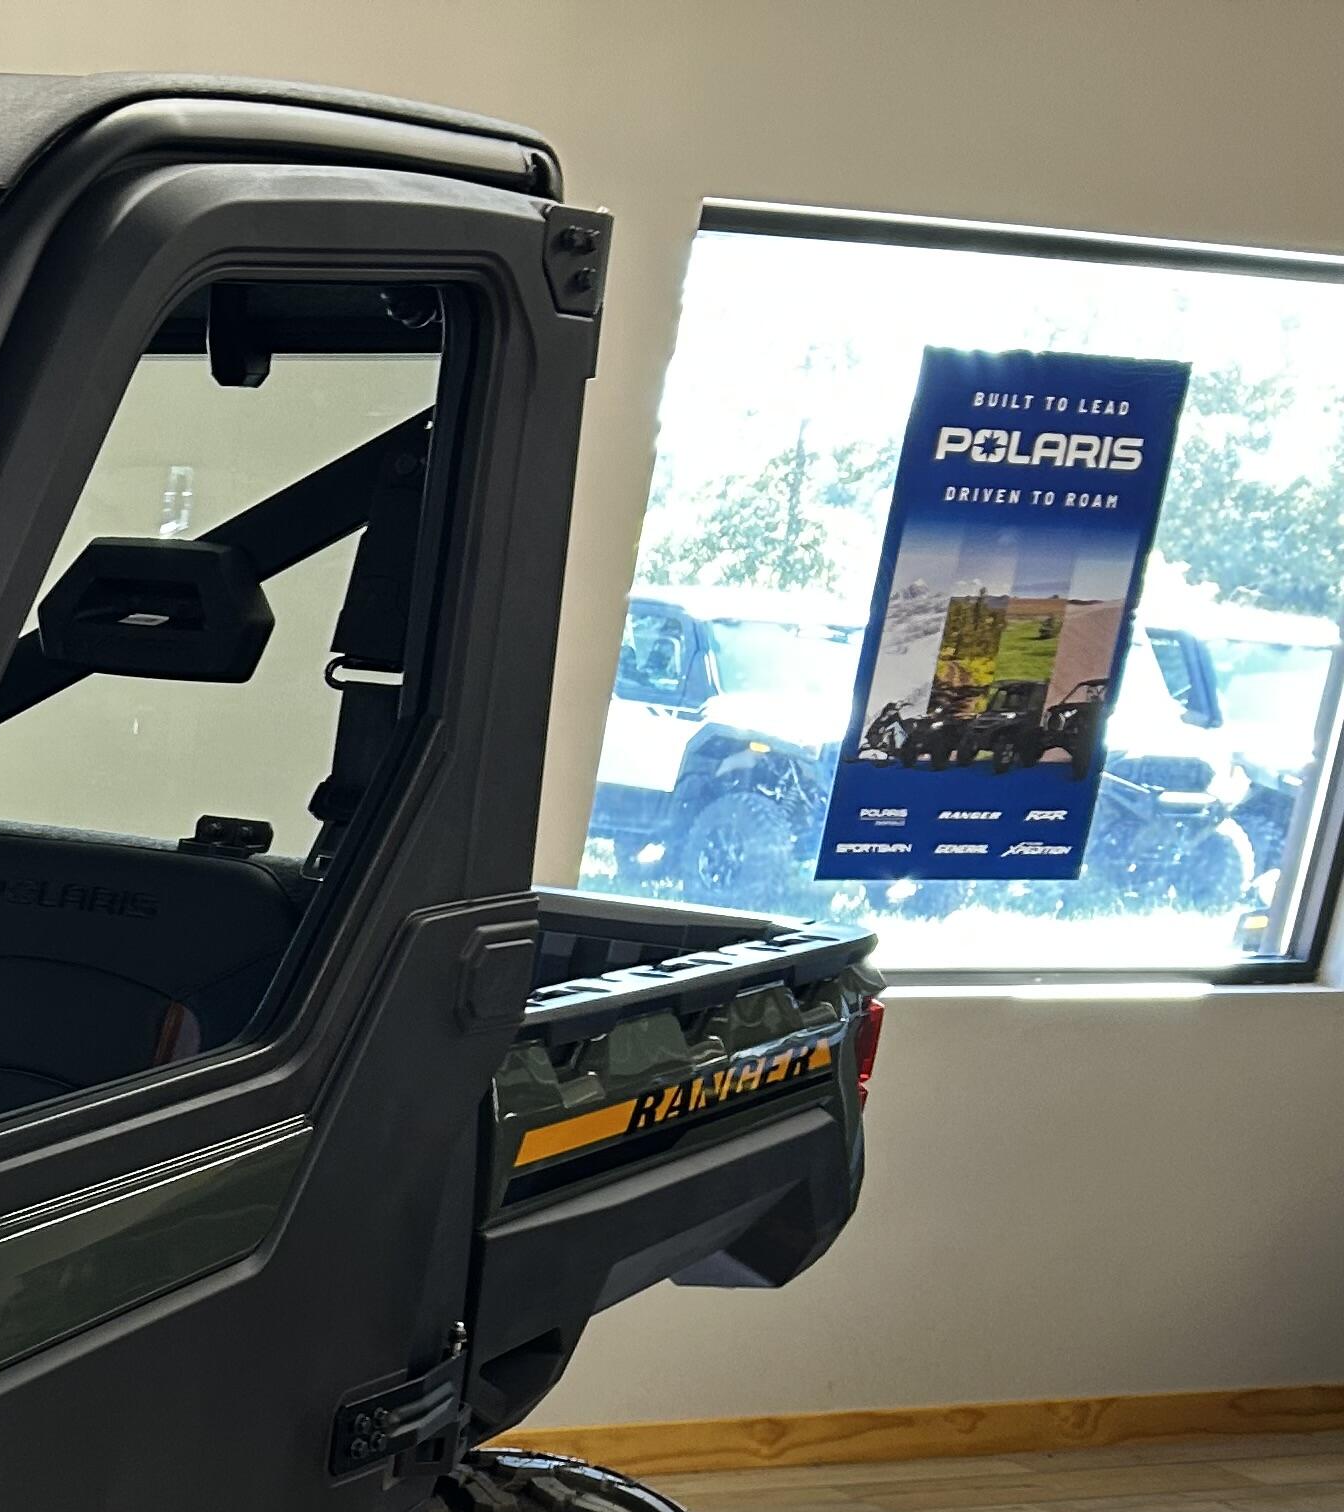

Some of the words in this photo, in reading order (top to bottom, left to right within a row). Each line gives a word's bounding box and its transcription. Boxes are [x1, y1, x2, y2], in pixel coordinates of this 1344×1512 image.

[973, 391, 1035, 410] BUILT
[1044, 396, 1068, 412] TO
[1077, 399, 1131, 416] LEAD
[935, 426, 1145, 471] POLARIS
[944, 486, 1020, 504] DRIVEN
[1031, 490, 1056, 506] TO
[1064, 492, 1120, 509] ROAM
[937, 811, 1003, 820] RANGER
